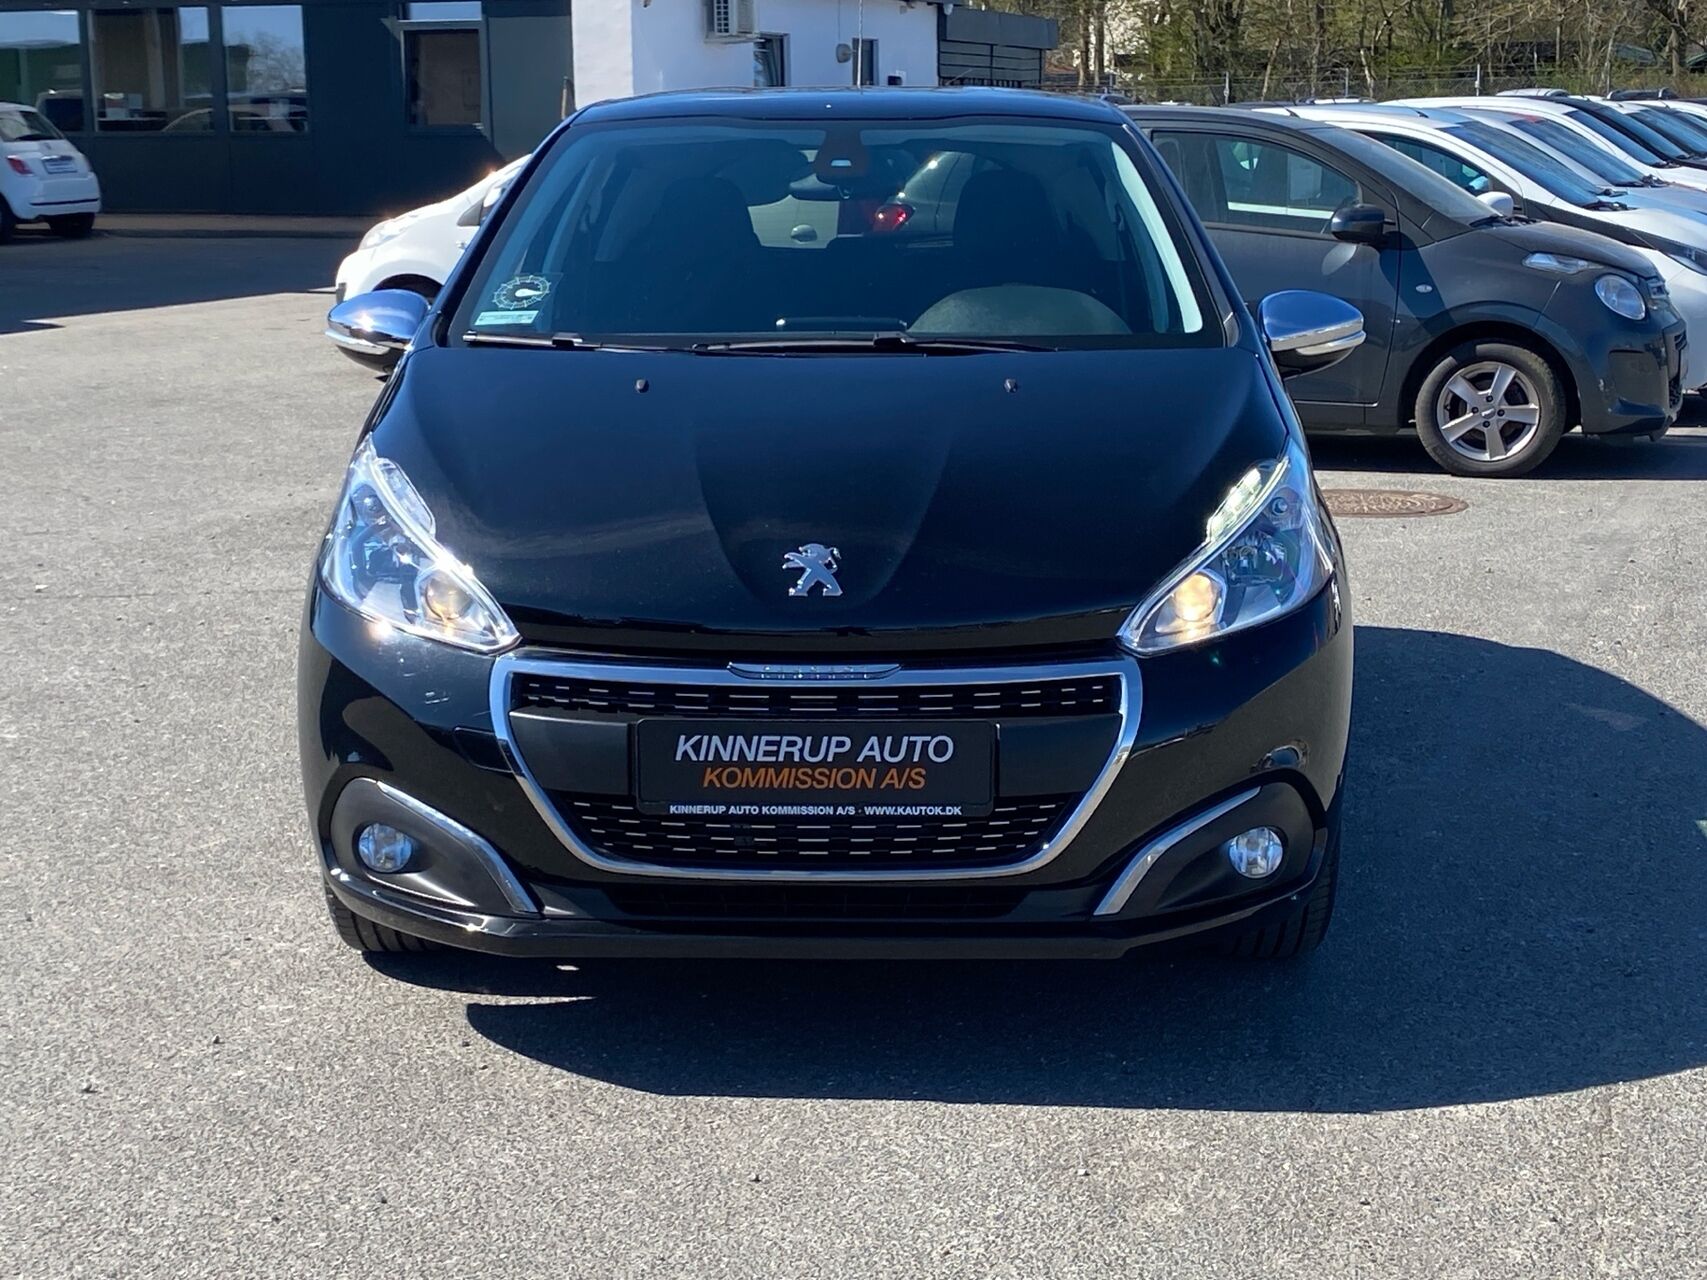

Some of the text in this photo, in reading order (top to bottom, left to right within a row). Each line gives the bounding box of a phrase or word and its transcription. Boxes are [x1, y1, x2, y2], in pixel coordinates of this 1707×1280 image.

[675, 734, 954, 763] KINNERUP AUTO
[703, 766, 927, 789] KOMMISSION A/S
[669, 805, 962, 816] KINNERUP AUTO KOMMISSION A/S WWW.KAUTOK.DK
